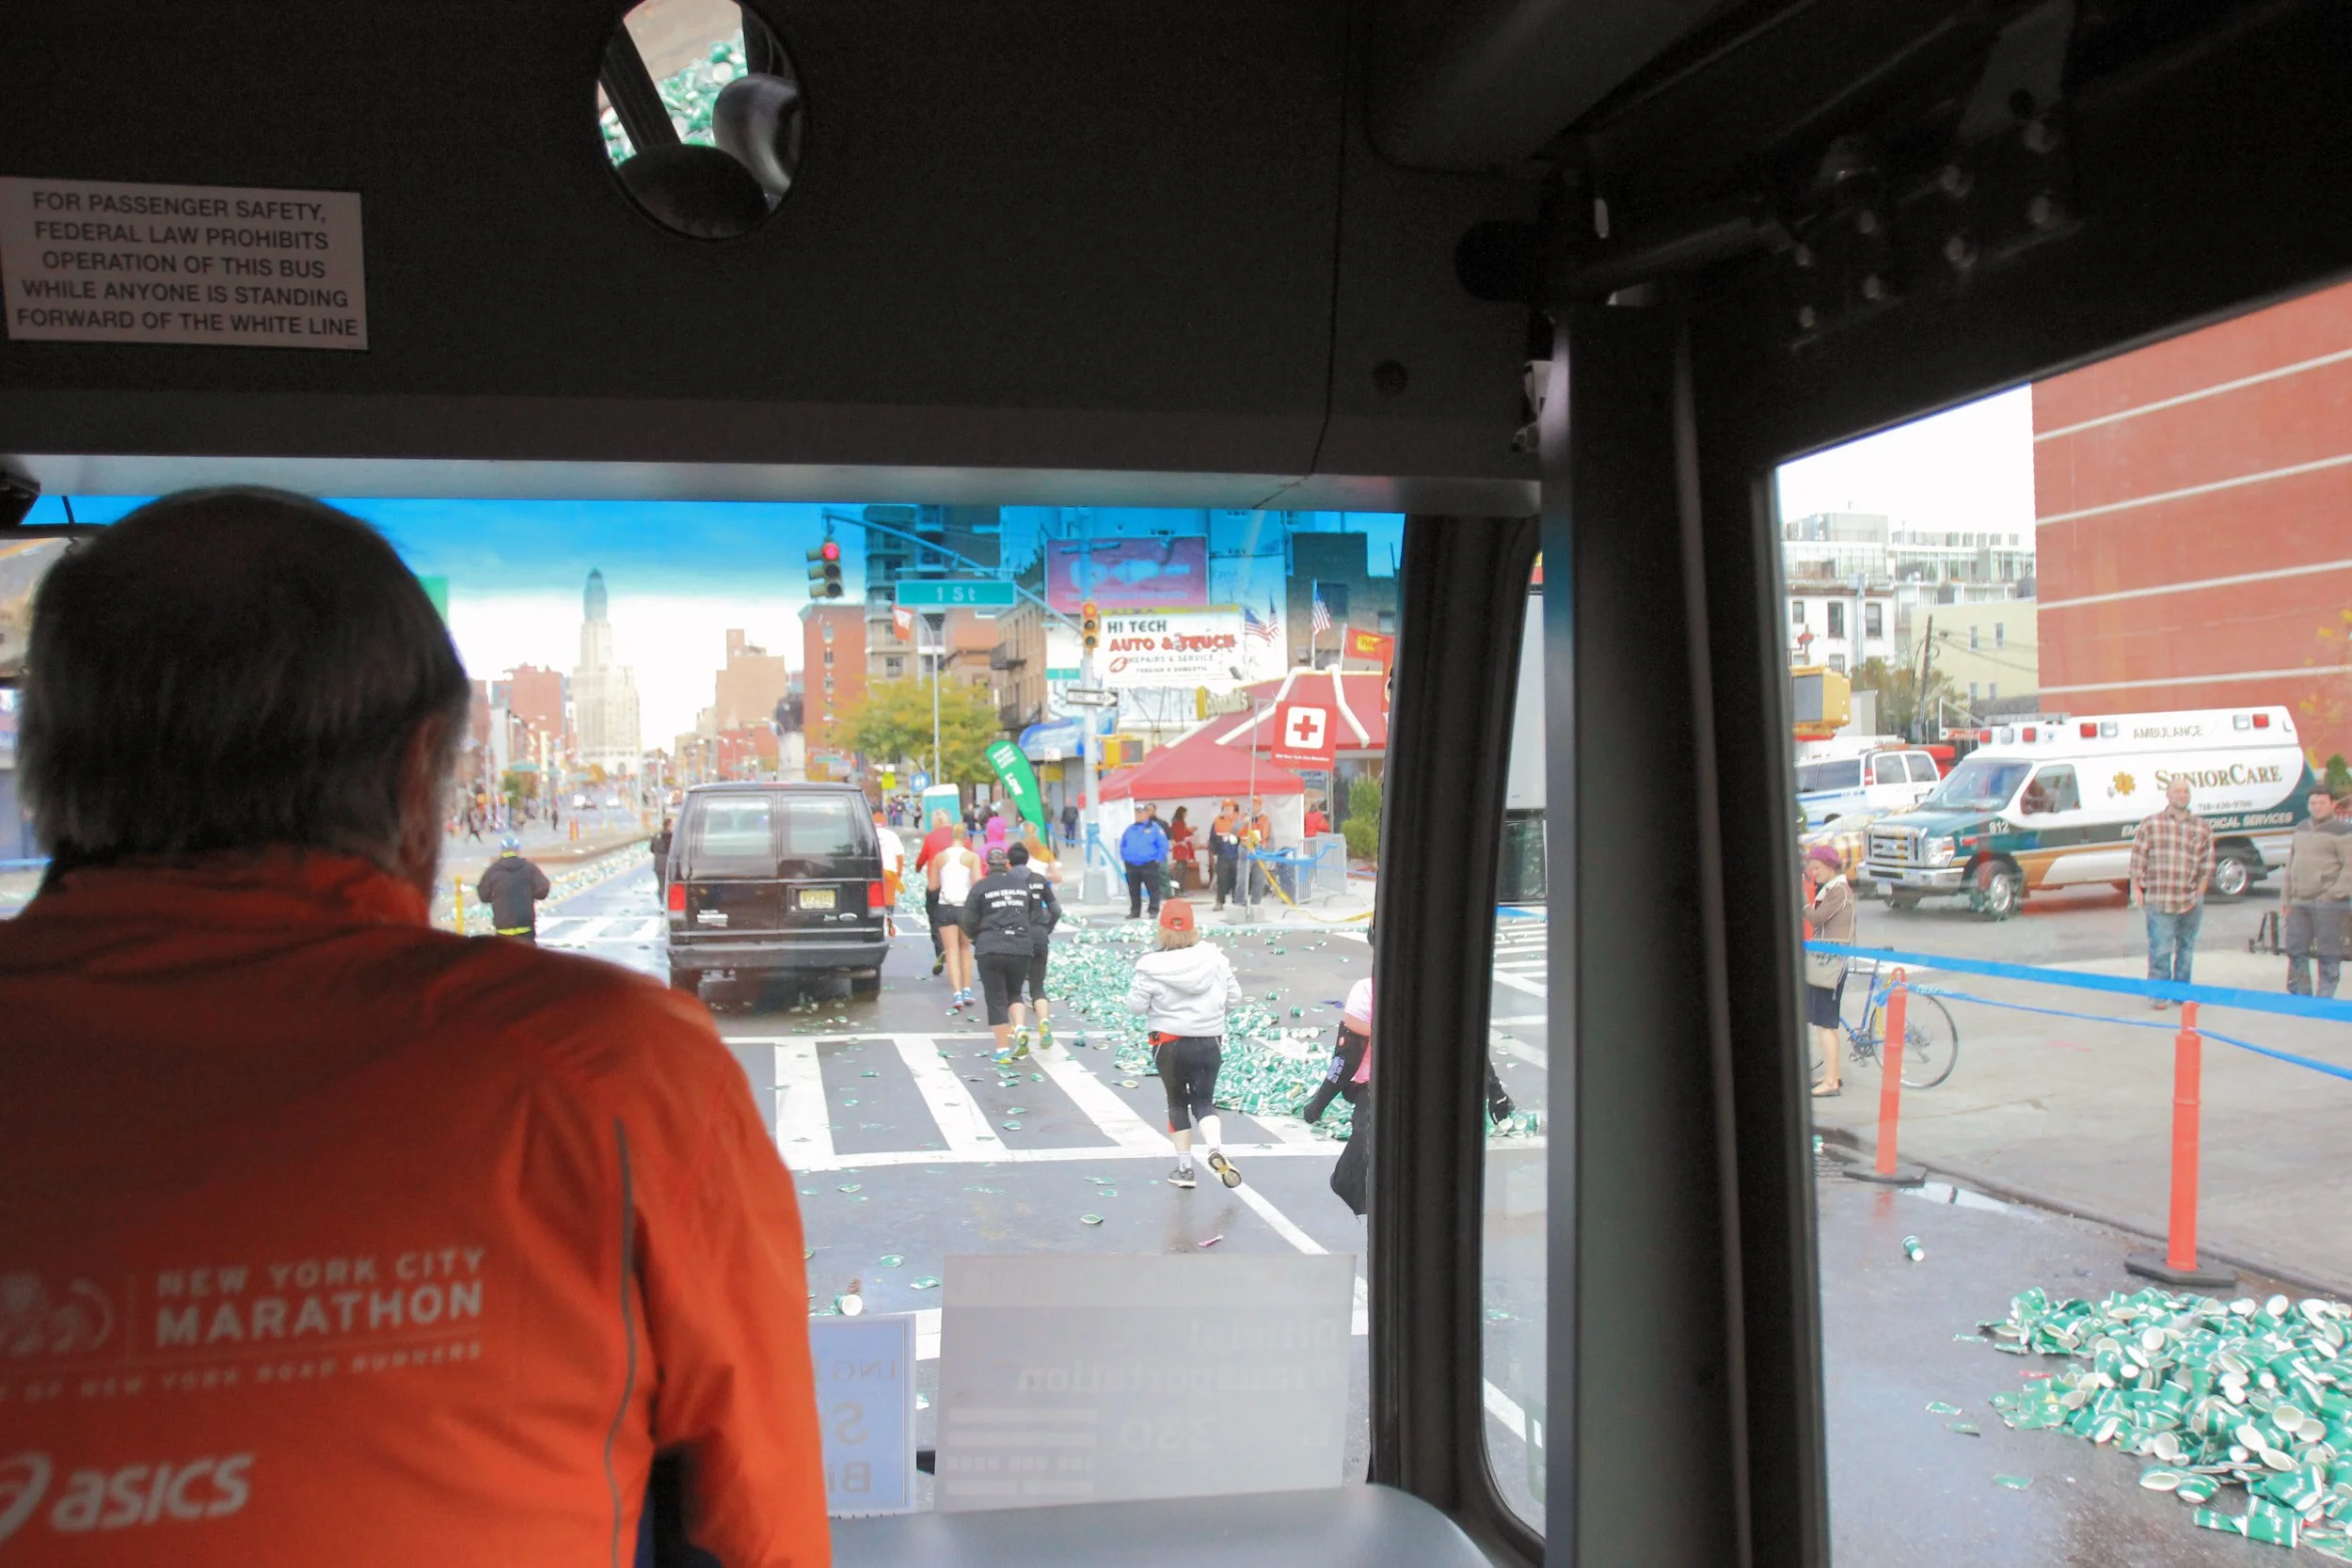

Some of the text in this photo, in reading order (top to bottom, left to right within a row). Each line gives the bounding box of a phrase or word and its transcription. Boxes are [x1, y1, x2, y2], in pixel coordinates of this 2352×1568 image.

[32, 191, 326, 224] FOR PASSENGER SAFETY,
[34, 221, 328, 250] FEDERAL LAW PROHIBITS
[42, 250, 326, 279] OPERATION OF THIS BUS
[22, 279, 348, 308] WHILE ANYONE IS STANDING
[17, 309, 358, 336] FORWARD OF THE WHITE LINE
[952, 586, 976, 602] St
[1107, 620, 1167, 633] HI TECH
[1109, 634, 1236, 652] AUTO & TRUCK
[1178, 653, 1214, 662] SERVICE
[2133, 725, 2203, 739] AMBULANCE
[2245, 812, 2293, 827] SERVICES
[157, 1247, 486, 1298] NEW YORK CITY
[155, 1280, 483, 1347] MARATHON
